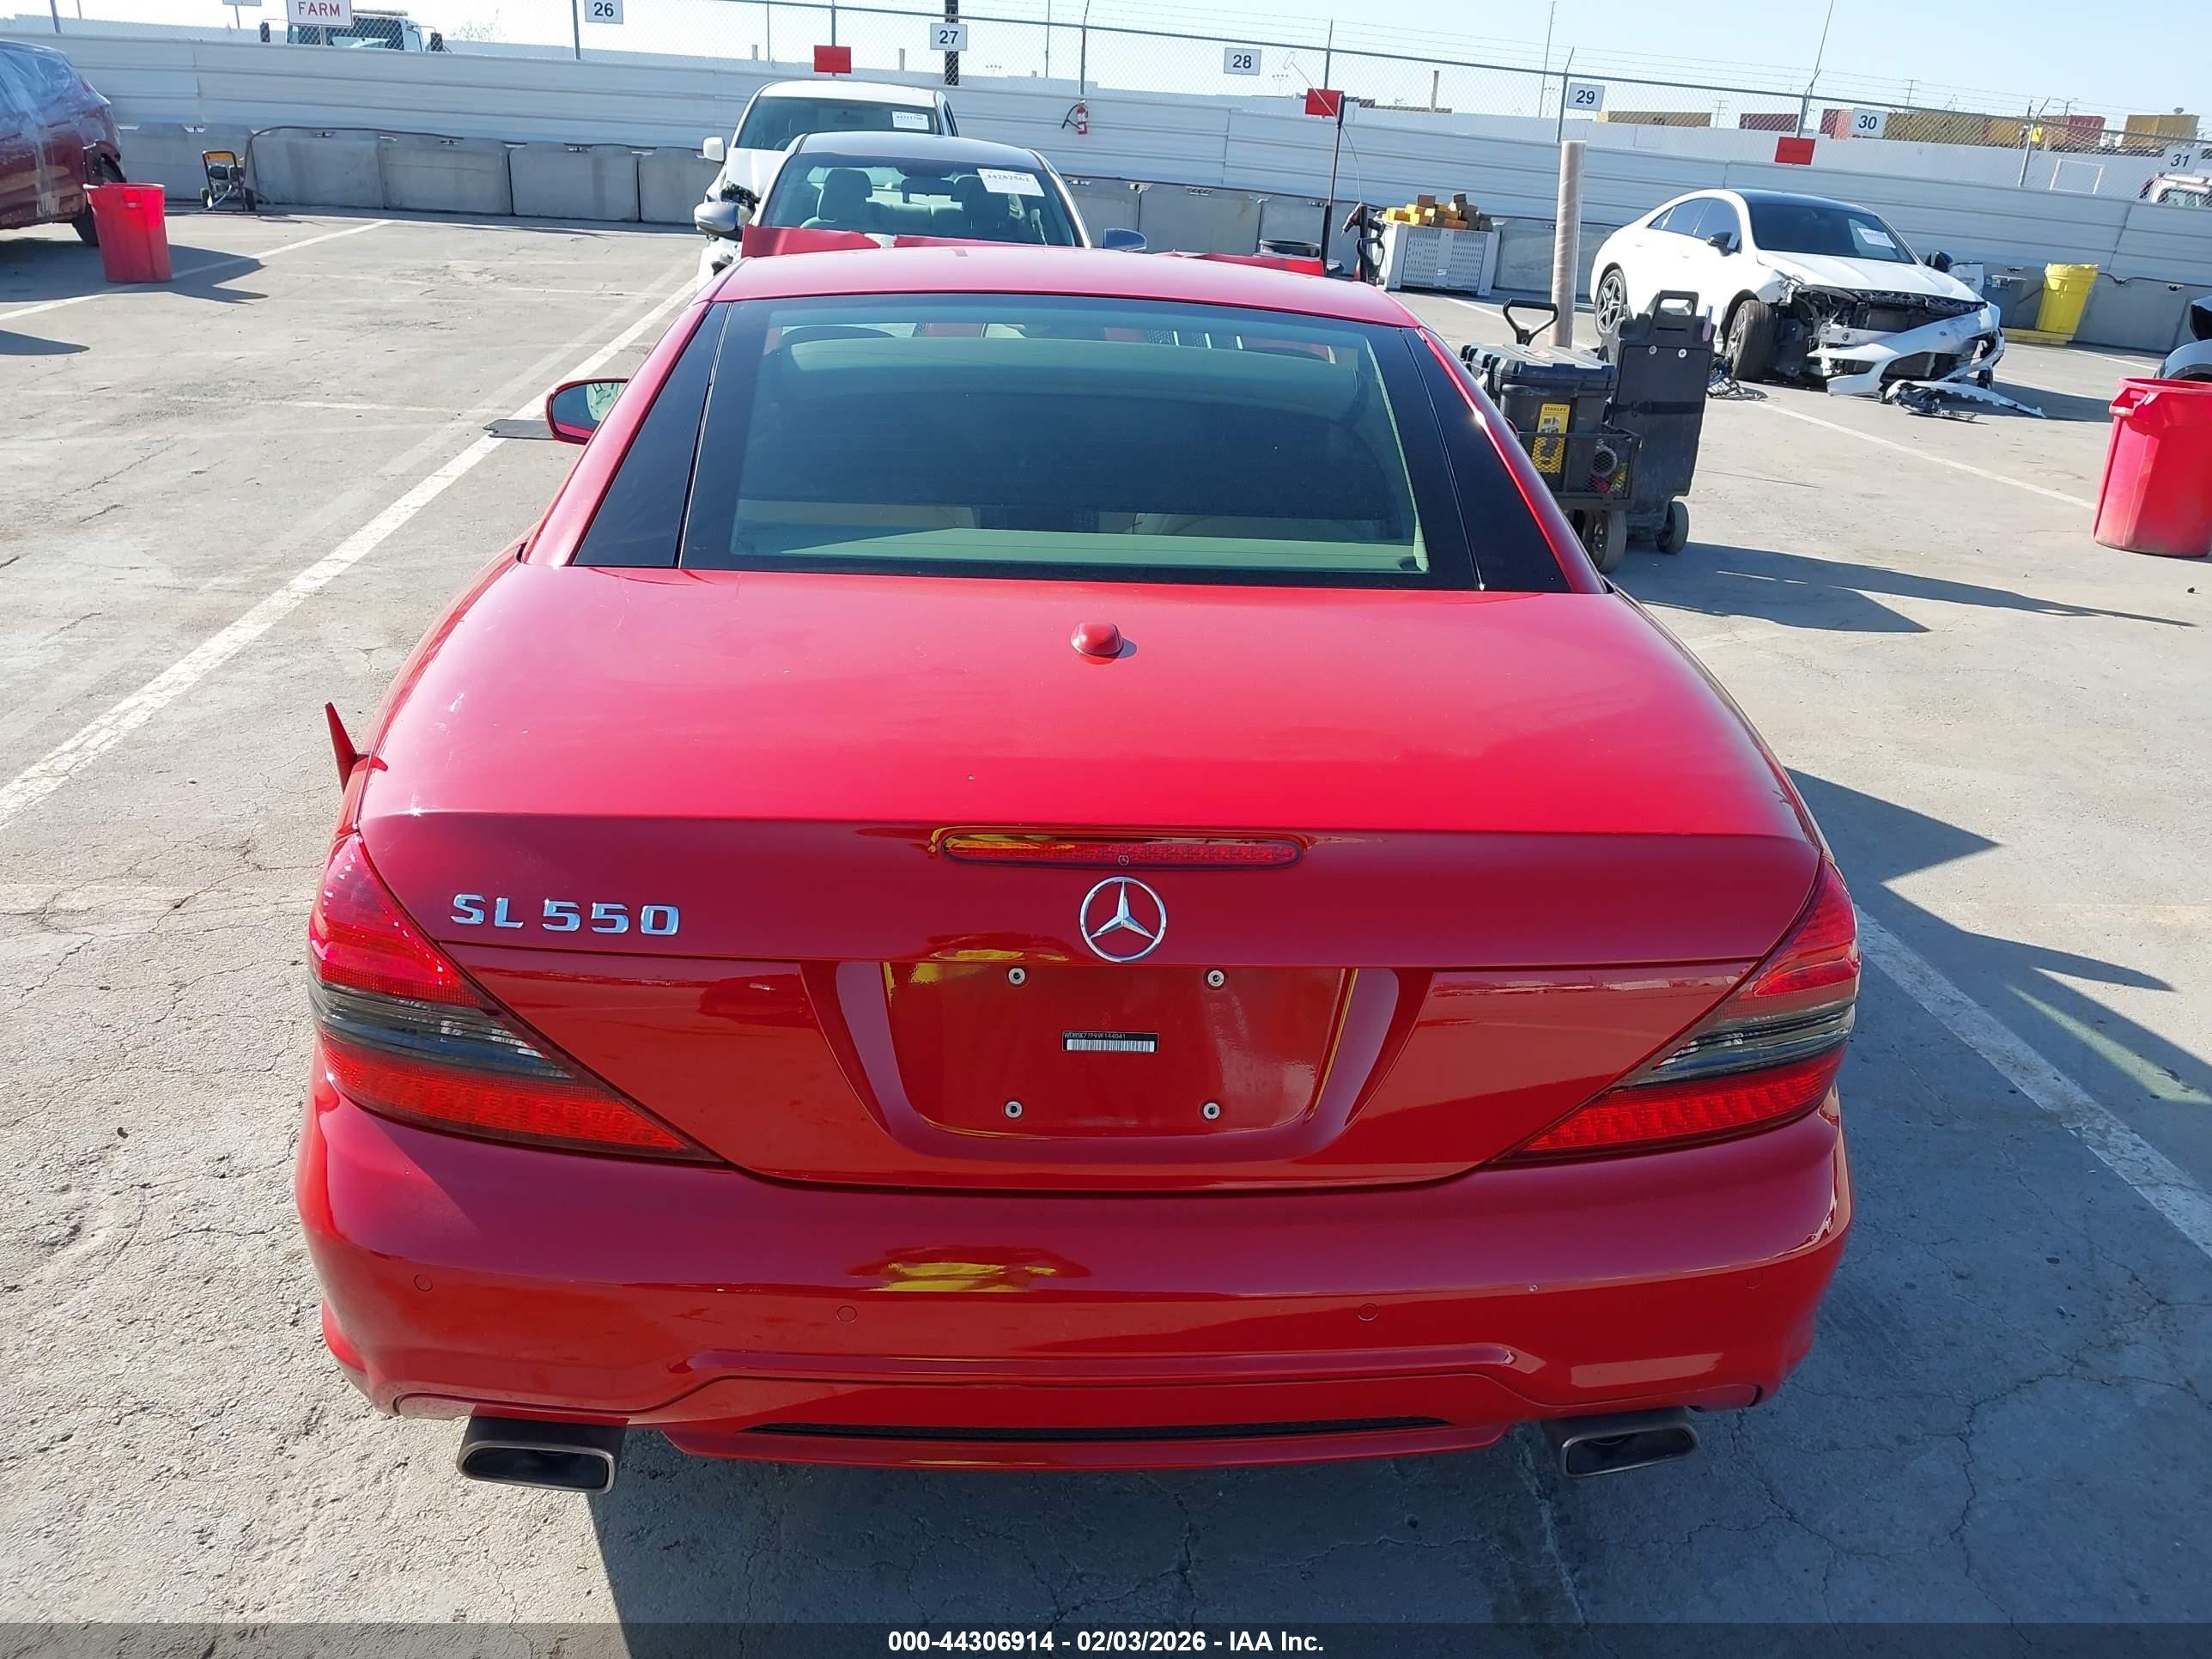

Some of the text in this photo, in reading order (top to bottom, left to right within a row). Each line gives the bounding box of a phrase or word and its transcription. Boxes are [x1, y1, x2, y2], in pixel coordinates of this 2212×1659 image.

[297, 2, 341, 17] FARM
[593, 2, 614, 17] 26
[939, 29, 959, 45] 27
[1232, 54, 1252, 69] 28
[1575, 89, 1595, 105] 29
[1857, 114, 1878, 131] 30
[2170, 153, 2191, 167] 31
[449, 893, 679, 935] SL 550
